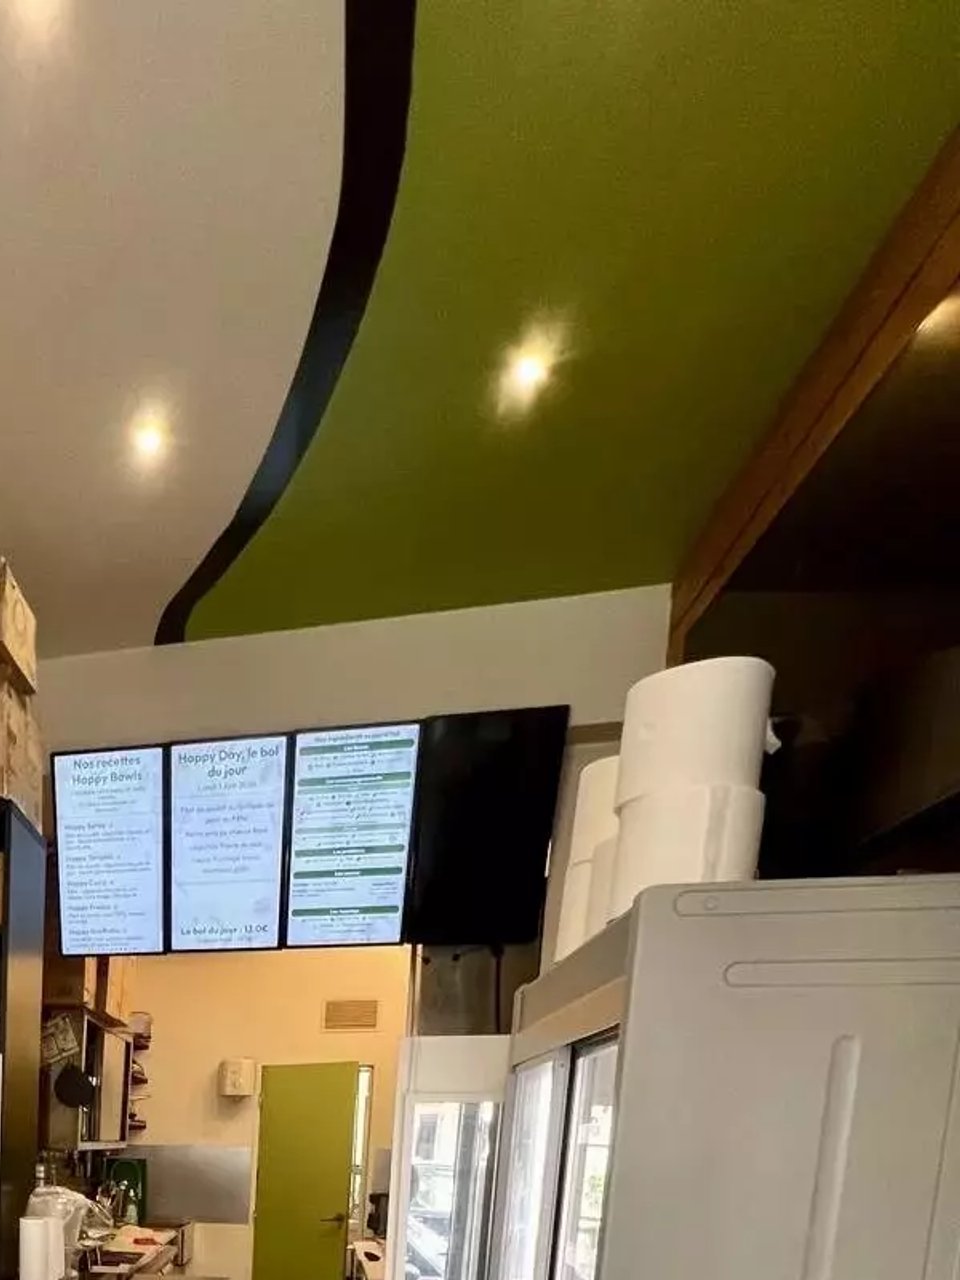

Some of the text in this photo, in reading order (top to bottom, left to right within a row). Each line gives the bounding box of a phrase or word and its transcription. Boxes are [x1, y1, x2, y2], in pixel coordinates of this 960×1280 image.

[73, 756, 141, 769] Nos recettes
[178, 745, 279, 765] Happy Day, le bol
[72, 770, 143, 786] Happy Bowls
[207, 765, 247, 779] du jour
